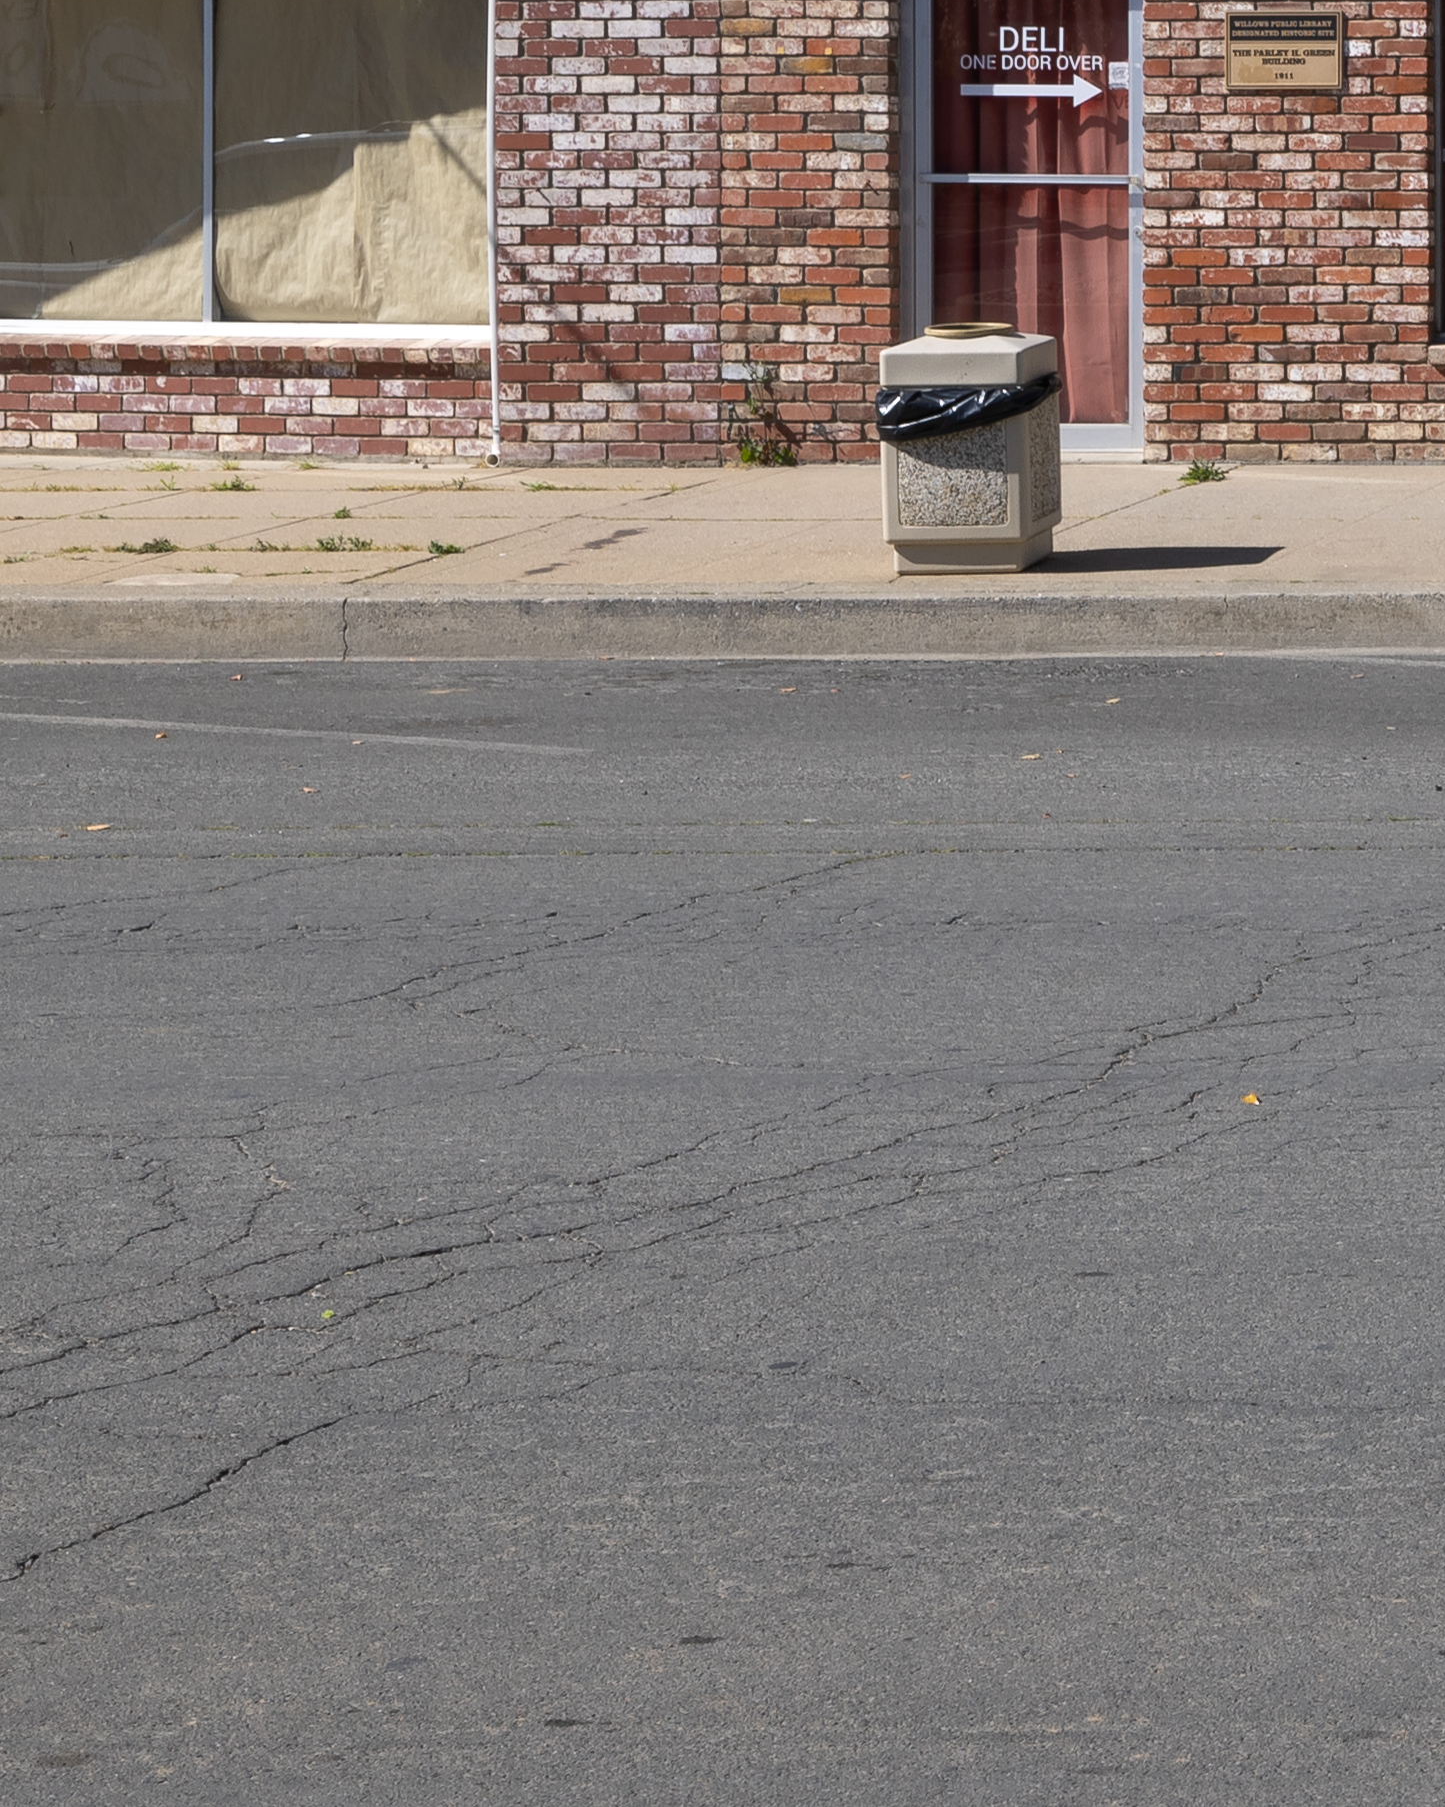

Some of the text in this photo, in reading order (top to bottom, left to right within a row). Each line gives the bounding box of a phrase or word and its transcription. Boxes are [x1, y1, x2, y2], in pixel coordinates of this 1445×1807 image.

[999, 26, 1065, 52] DELI
[1233, 49, 1251, 57] THE
[1253, 49, 1289, 57] PARLEY
[1303, 49, 1335, 57] GREEN
[960, 54, 1104, 72] ONE DOOR OVER
[1261, 58, 1307, 66] BUILDING
